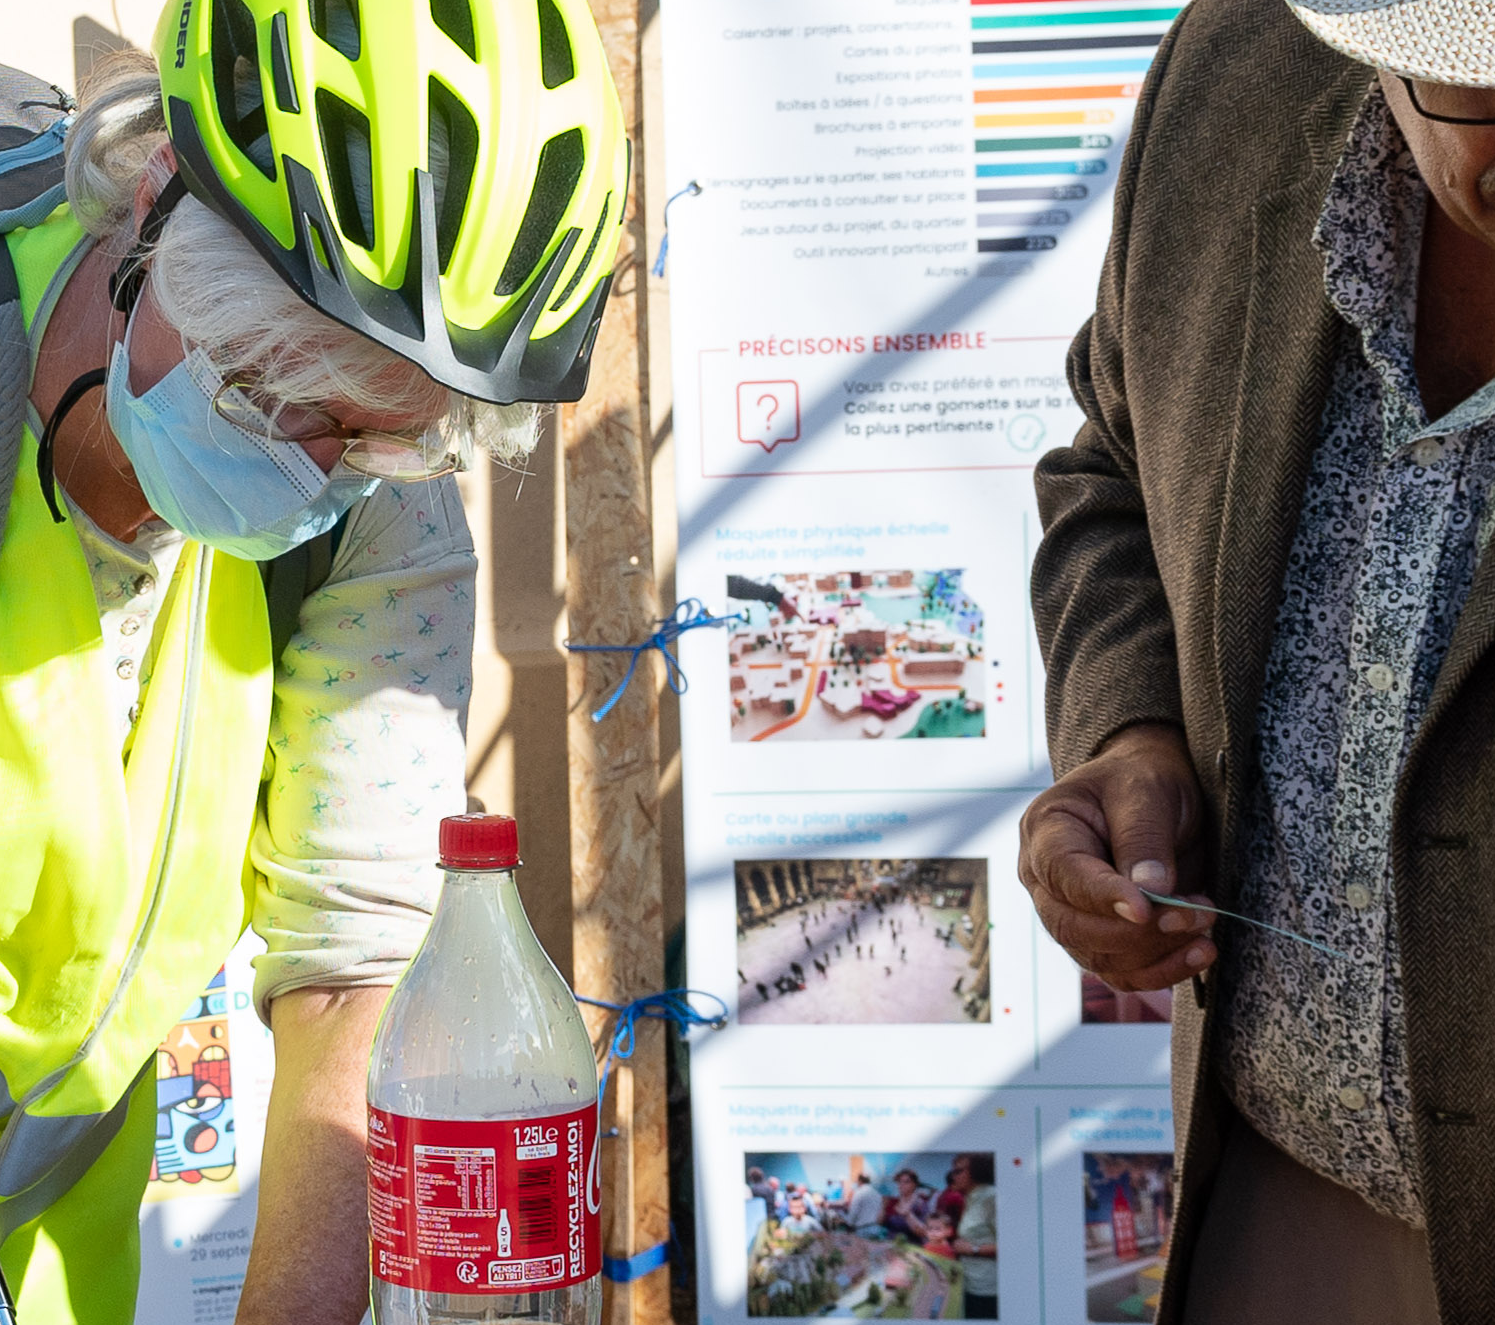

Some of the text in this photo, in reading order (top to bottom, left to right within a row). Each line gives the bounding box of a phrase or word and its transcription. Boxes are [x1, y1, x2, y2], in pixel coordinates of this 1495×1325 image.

[739, 331, 986, 357] PRÉCISONS ENSEMBLE
[843, 376, 1021, 396] Vous avez préféré en
[843, 394, 1062, 418] Collez une gomette sur la
[844, 418, 995, 439] la plus pertinente
[513, 1125, 546, 1146] 1.25L
[568, 1120, 580, 1278] RECYCLEZ-MOI
[190, 1226, 250, 1248] Mercredi
[190, 1248, 207, 1262] 29
